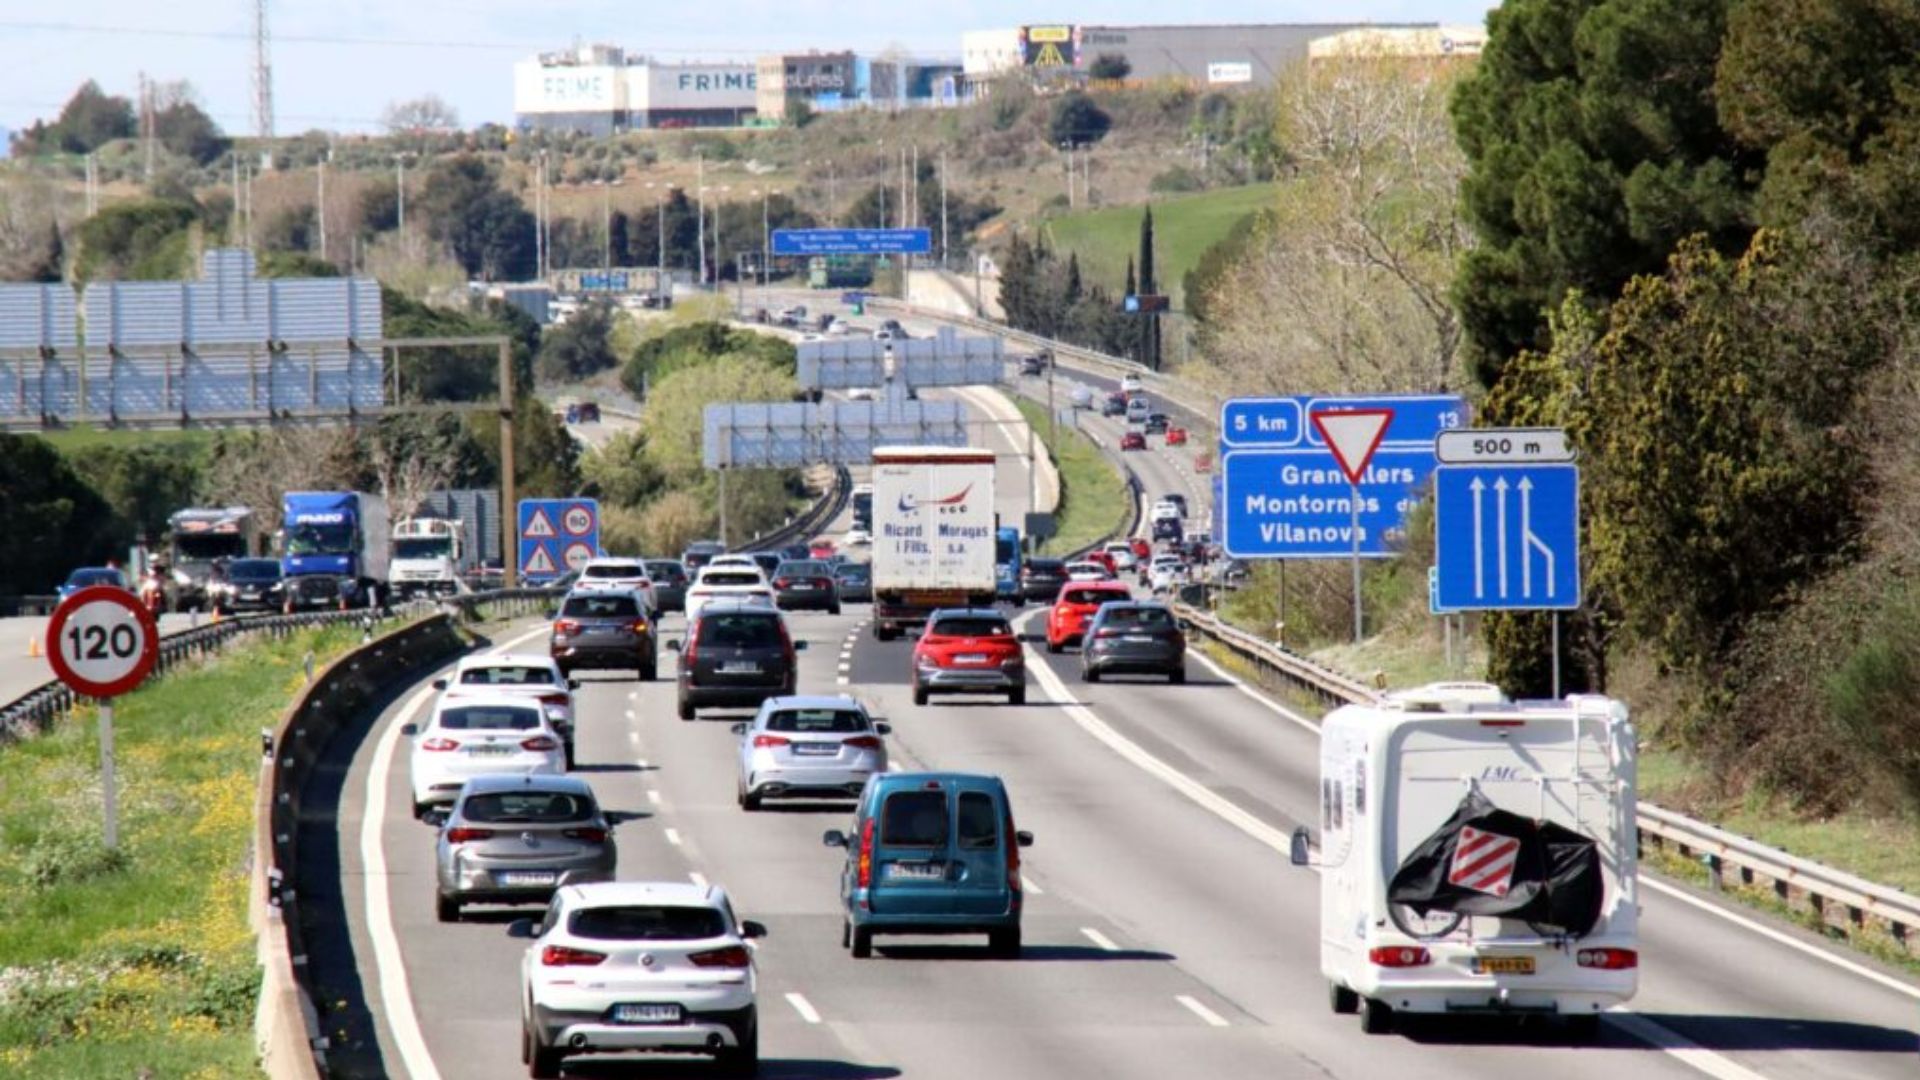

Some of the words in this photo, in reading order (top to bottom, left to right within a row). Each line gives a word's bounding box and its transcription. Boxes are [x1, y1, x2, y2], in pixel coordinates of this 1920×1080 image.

[544, 77, 604, 100] FRIME
[678, 73, 757, 91] FRIME
[1234, 415, 1247, 431] 5
[1258, 414, 1287, 431] km
[1438, 411, 1458, 428] 13
[1473, 439, 1512, 454] 500
[1524, 442, 1541, 454] m
[884, 523, 922, 537] Ricard
[938, 523, 988, 539] Moragas
[69, 623, 137, 661] 120
